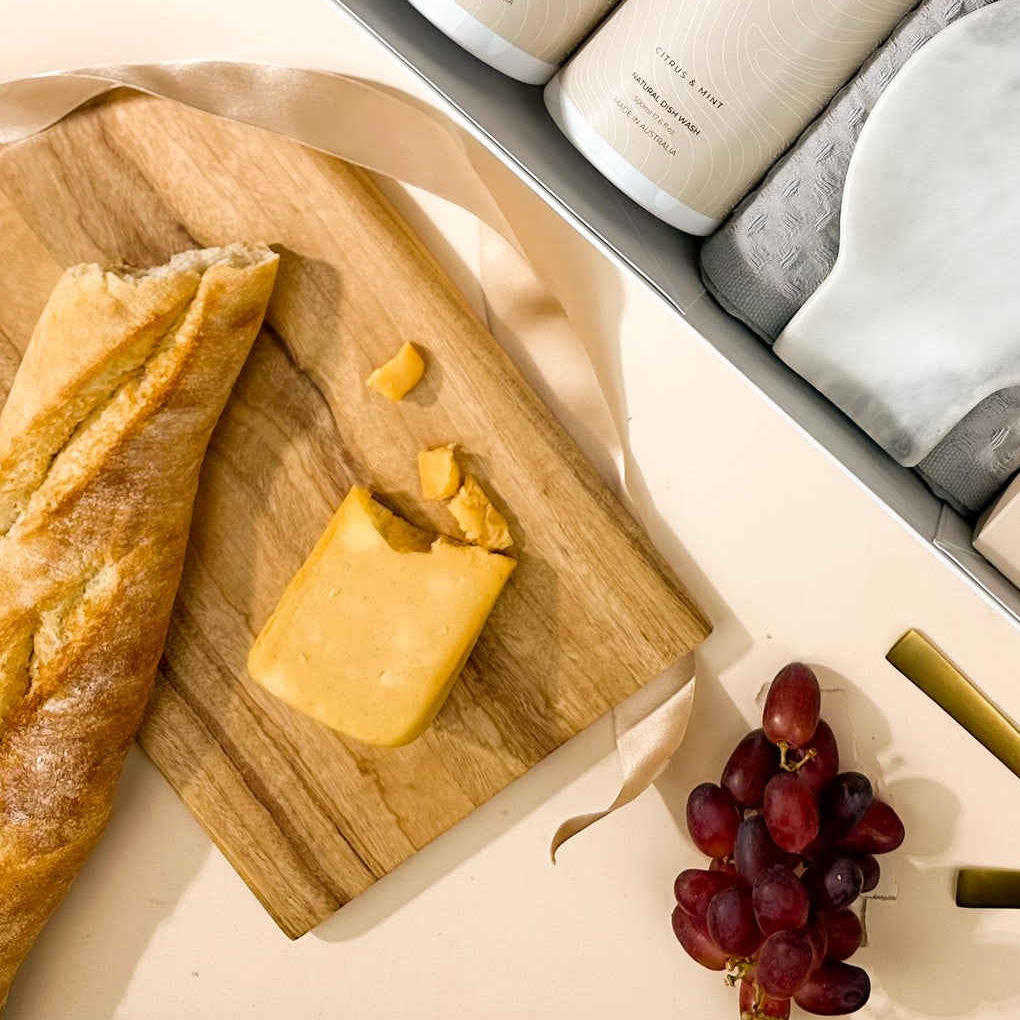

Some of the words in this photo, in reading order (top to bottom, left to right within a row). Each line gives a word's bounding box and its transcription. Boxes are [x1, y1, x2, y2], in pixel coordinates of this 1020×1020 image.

[631, 72, 660, 103] NATURAL
[660, 100, 679, 118] DISH
[678, 115, 701, 136] WASH
[655, 46, 688, 79] CITRUS
[688, 79, 696, 87] &
[697, 87, 724, 109] MINT
[613, 96, 632, 118] MADE
[632, 115, 641, 125] IN
[639, 123, 677, 157] AUSTRALIA
